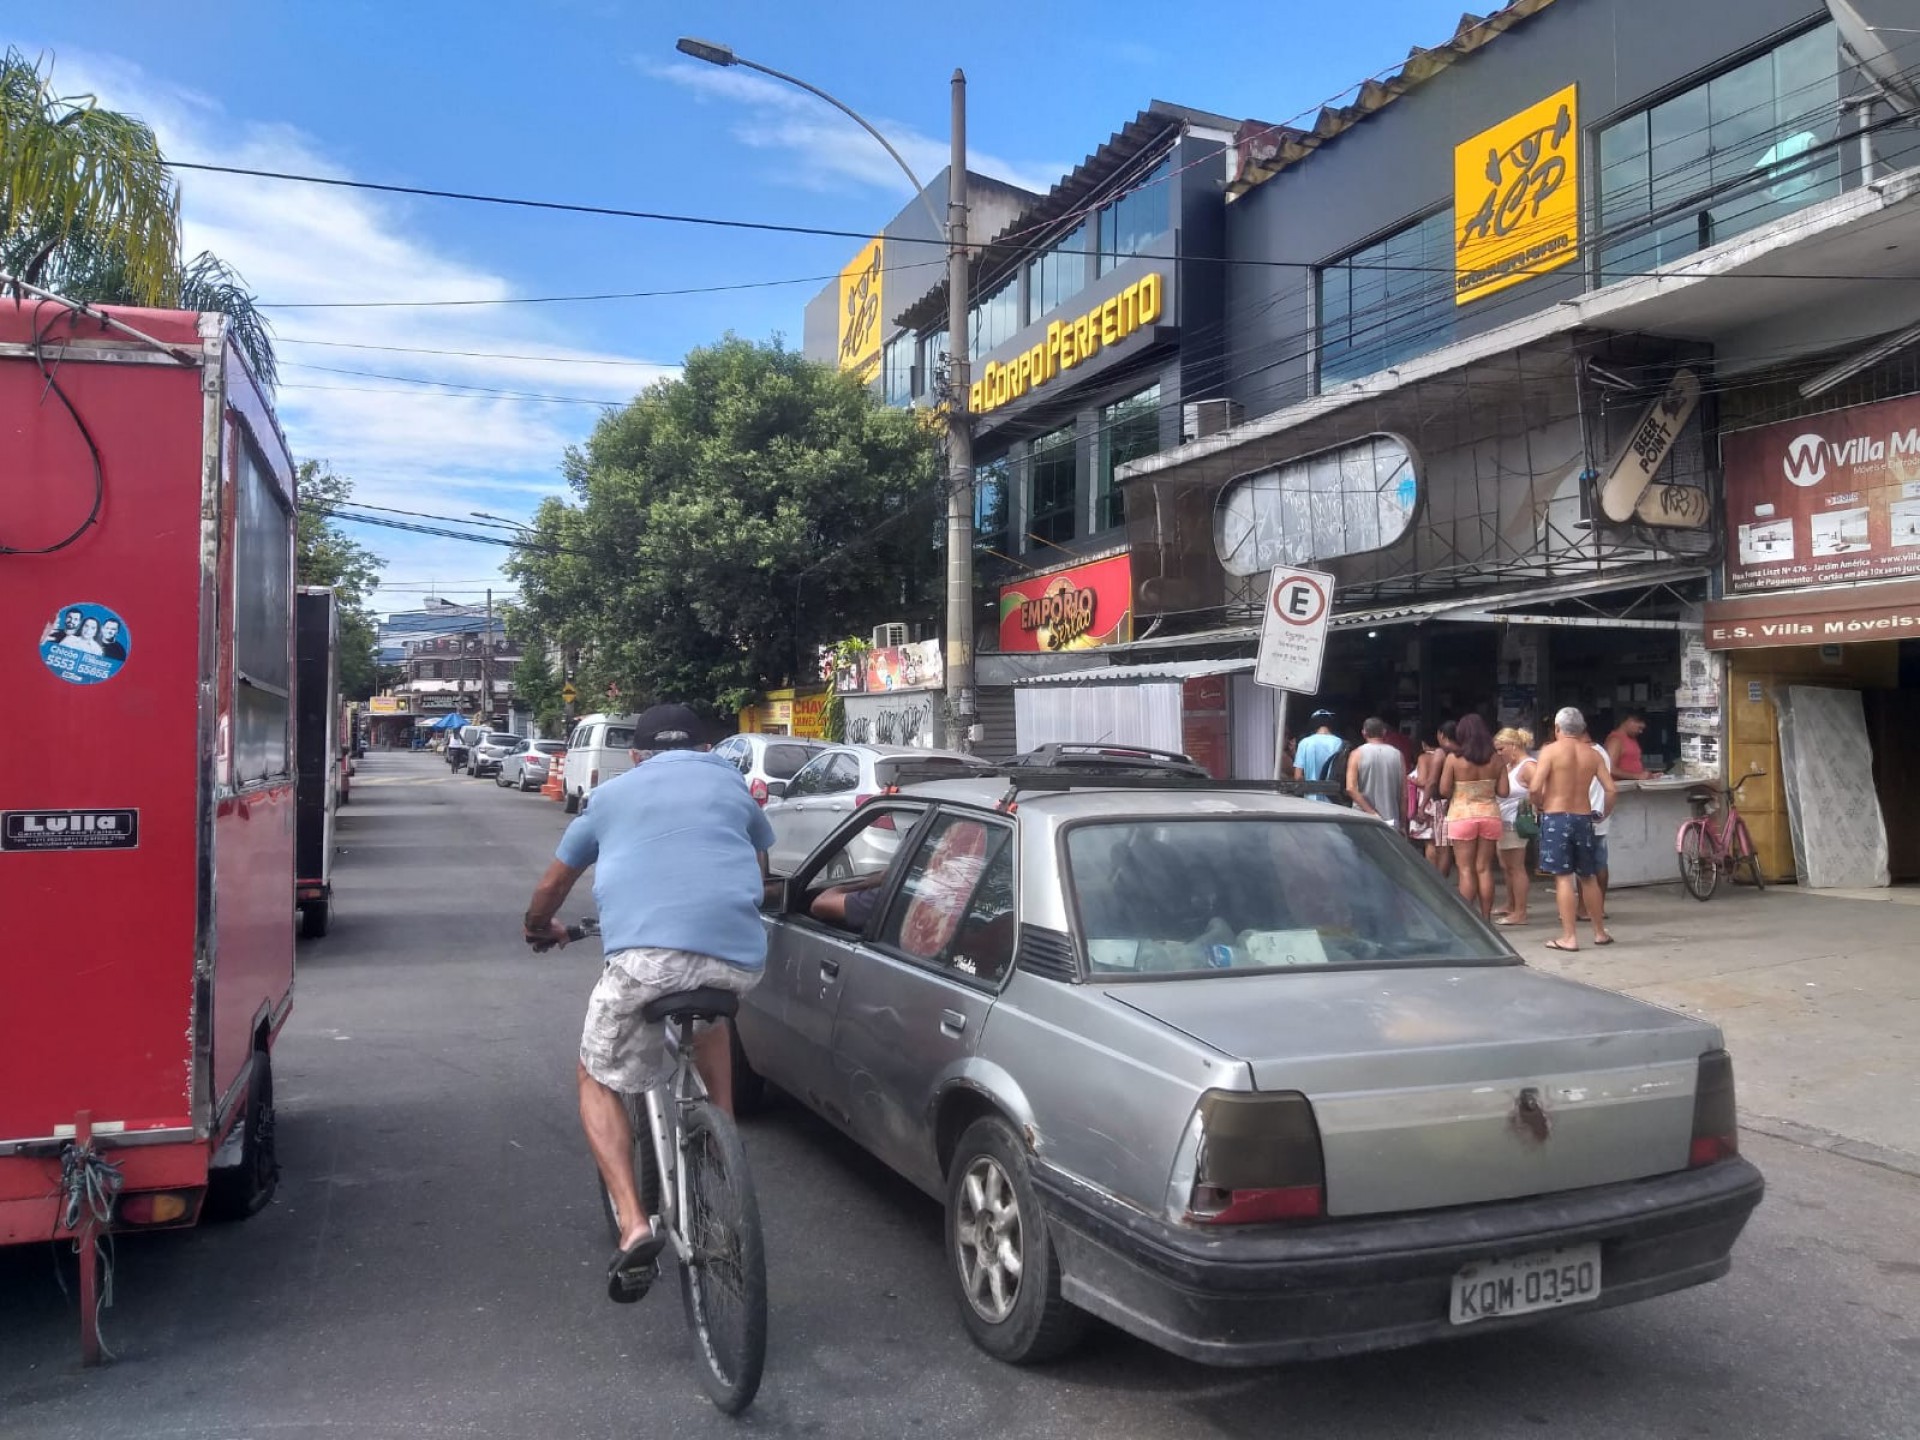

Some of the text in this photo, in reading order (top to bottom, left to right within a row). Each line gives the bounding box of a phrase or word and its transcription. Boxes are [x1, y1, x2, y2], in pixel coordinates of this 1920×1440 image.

[984, 273, 1162, 410] CORPO PERFEITO
[1633, 418, 1660, 457] BEER
[1639, 422, 1671, 474] POINT
[1831, 436, 1885, 467] Villa
[1289, 586, 1310, 616] E
[1713, 626, 1754, 640] E.S.
[1761, 623, 1814, 637] Villa
[1824, 615, 1913, 635] Móveis
[793, 699, 824, 714] CHAV
[23, 815, 116, 832] Lulla
